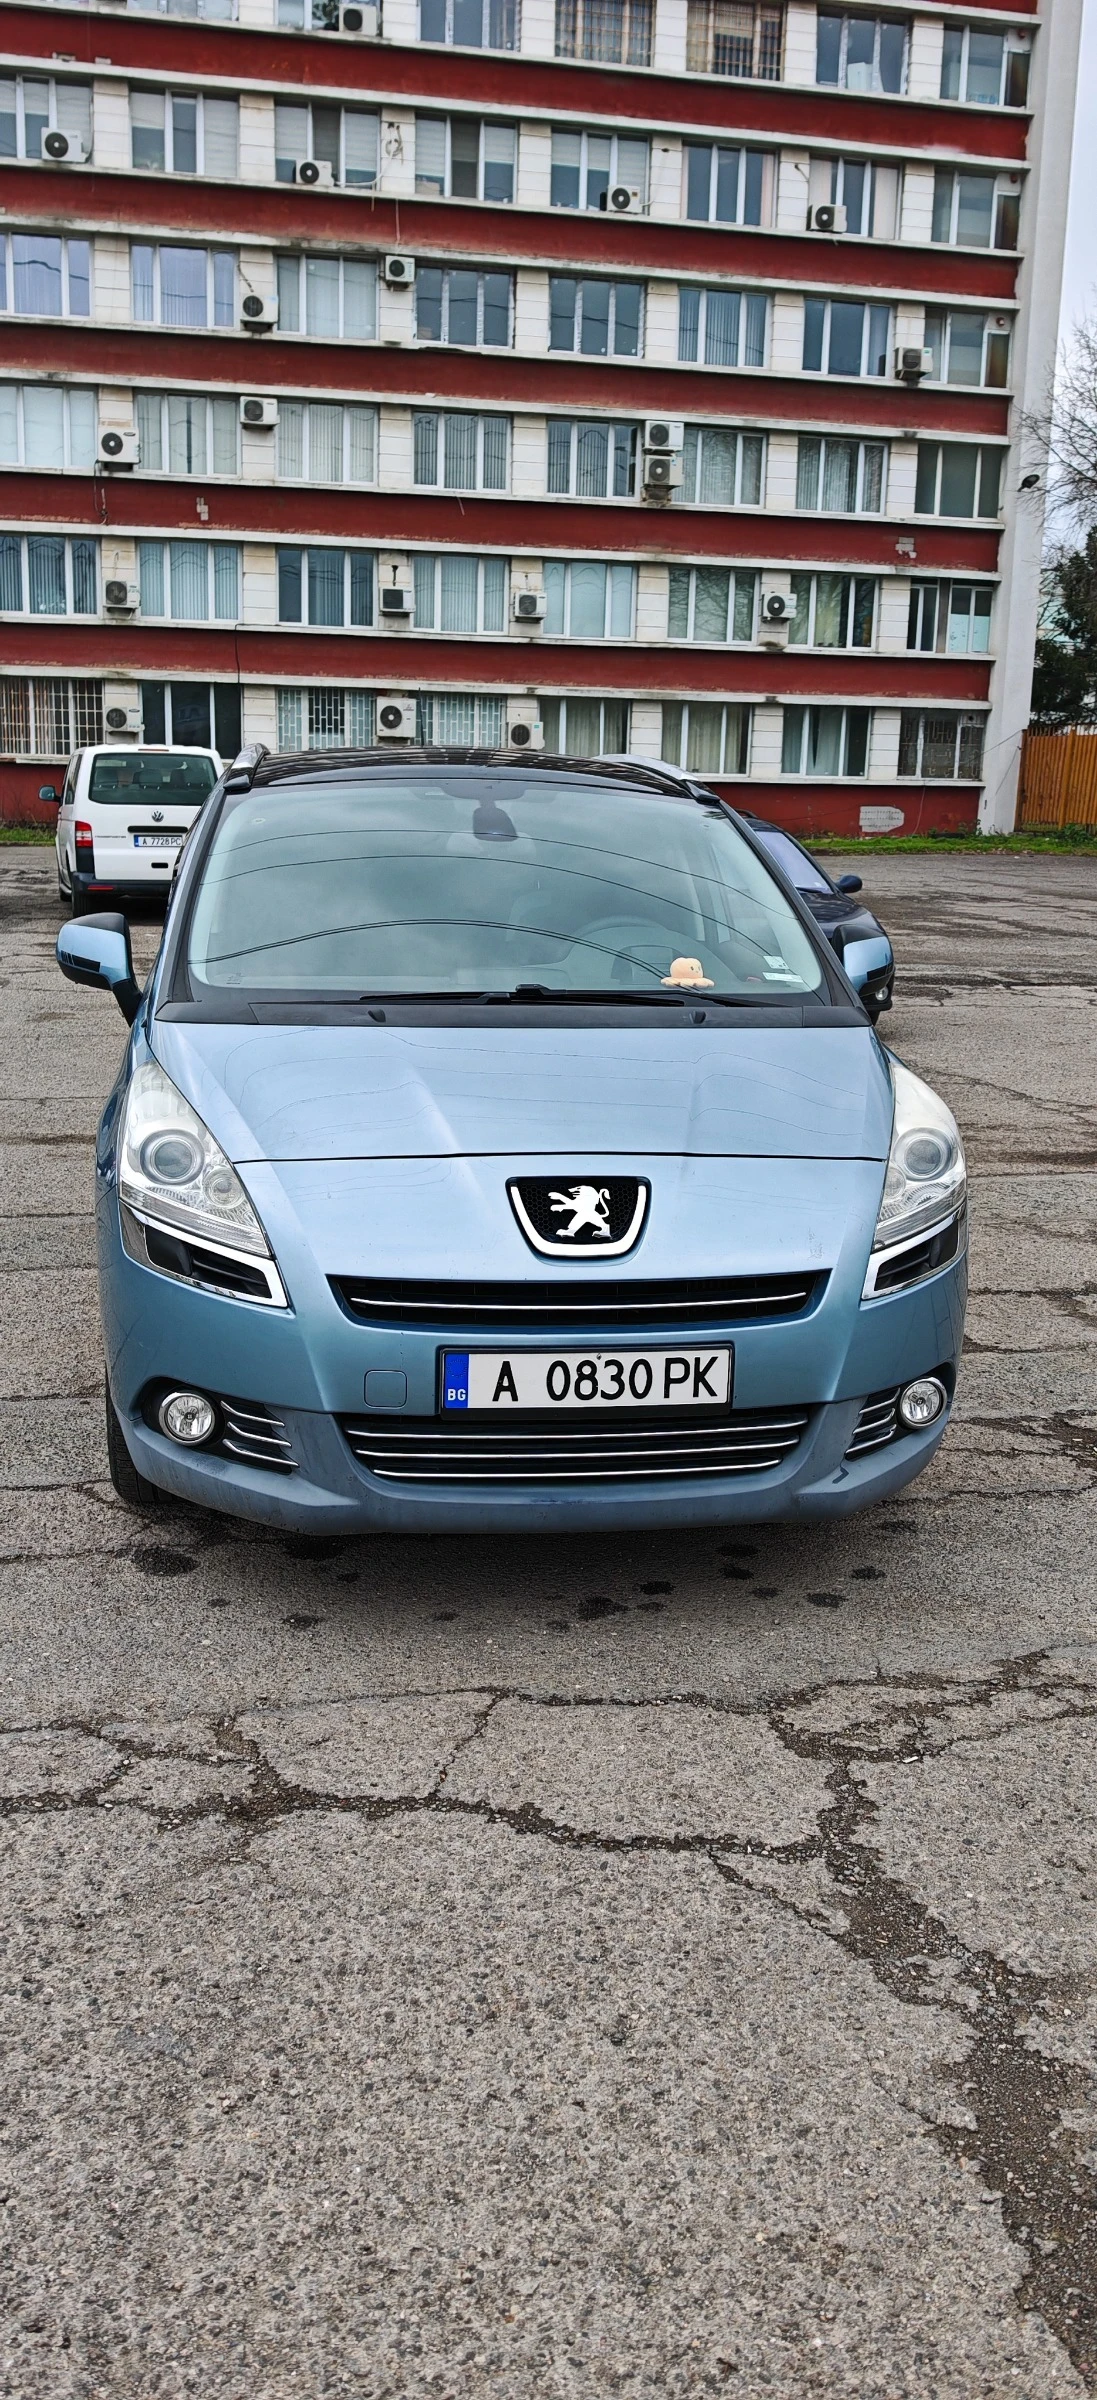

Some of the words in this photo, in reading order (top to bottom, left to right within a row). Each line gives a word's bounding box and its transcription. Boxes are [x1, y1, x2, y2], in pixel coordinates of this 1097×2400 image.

[151, 837, 169, 845] 7728
[171, 837, 181, 845] PC
[492, 1360, 519, 1402] A
[546, 1358, 653, 1402] 0830
[663, 1356, 719, 1399] PK
[447, 1388, 466, 1401] BG
